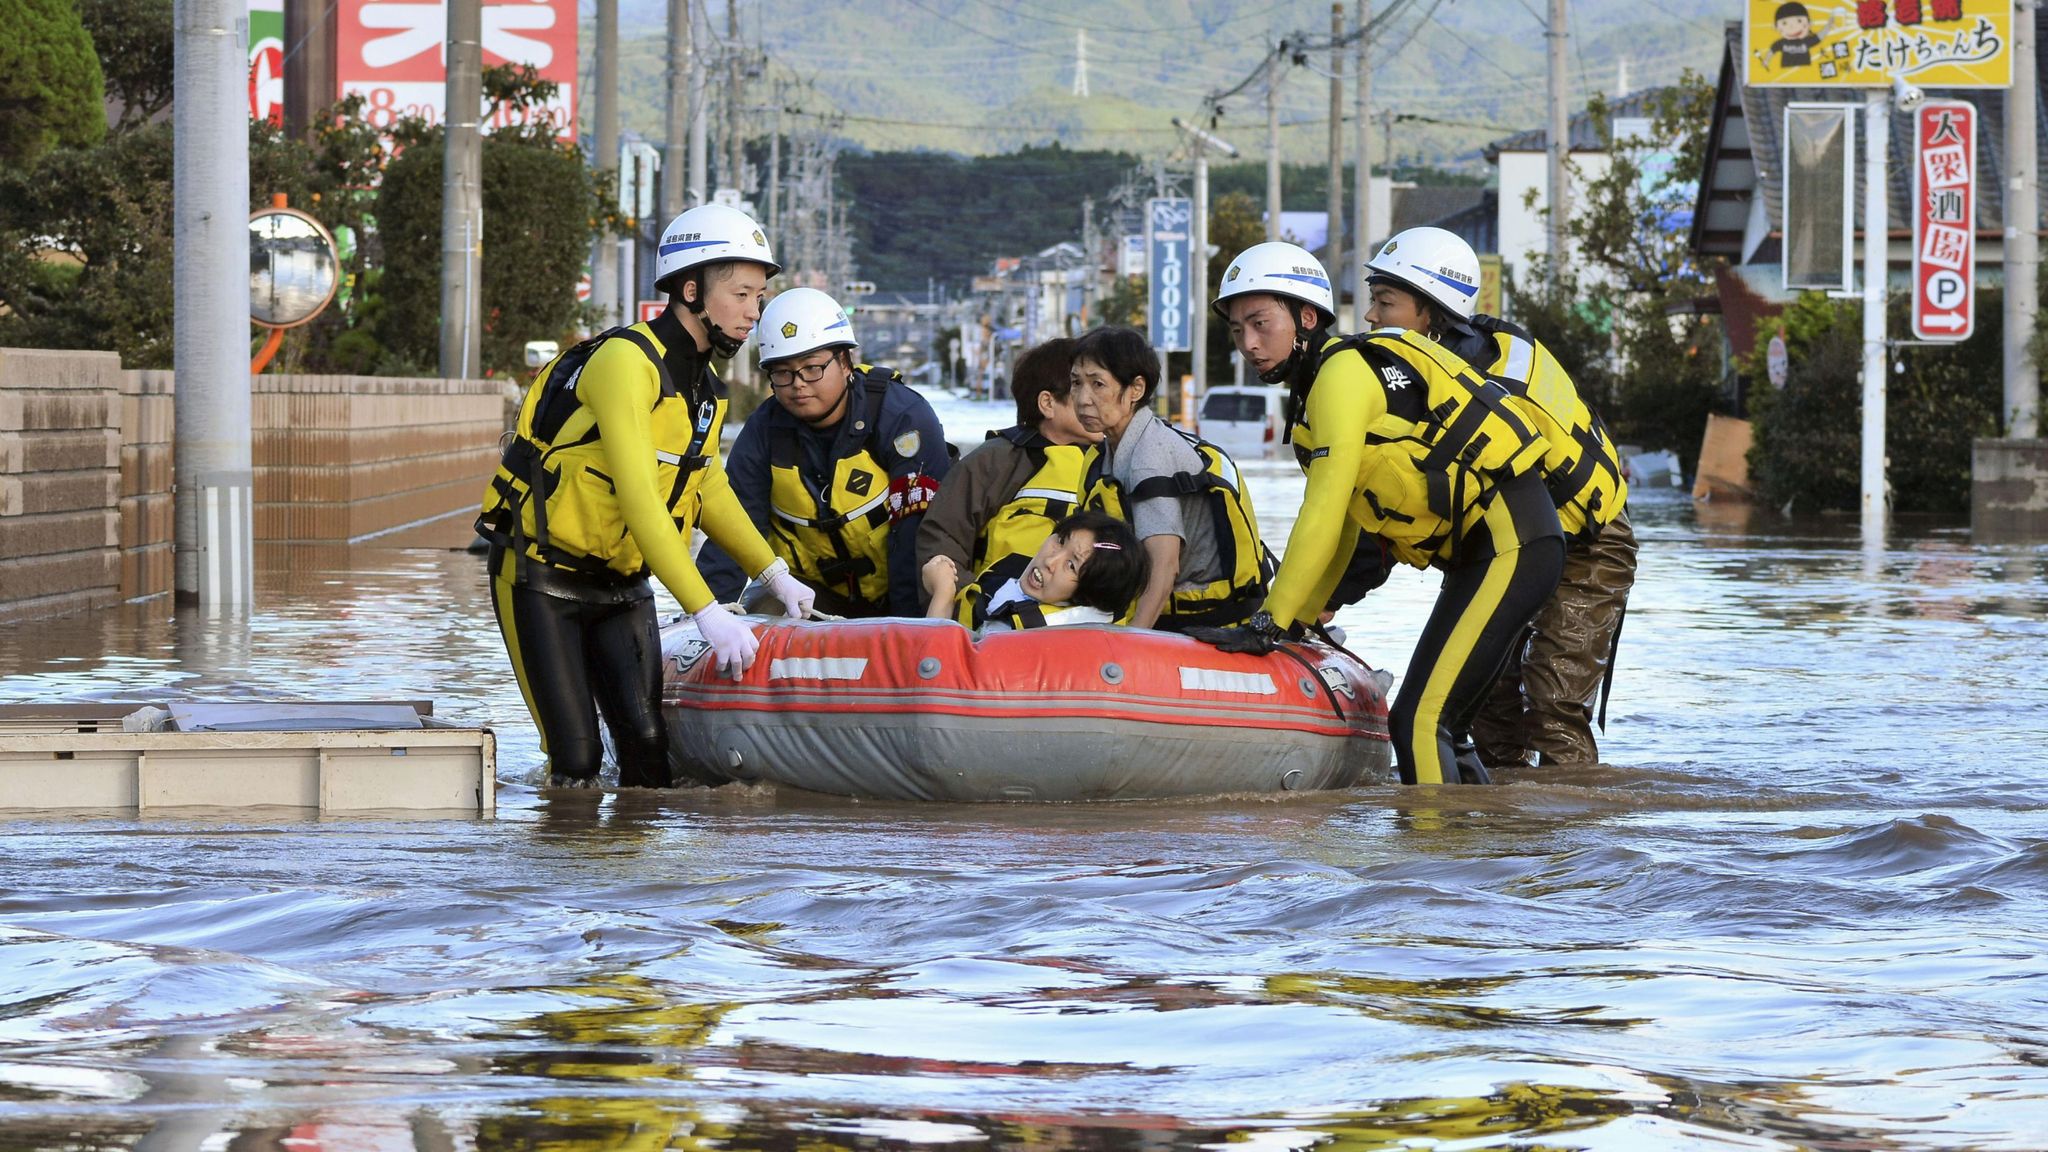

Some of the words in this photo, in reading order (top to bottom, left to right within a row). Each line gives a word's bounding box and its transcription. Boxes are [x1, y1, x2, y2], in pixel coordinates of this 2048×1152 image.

[1857, 18, 2000, 69] たけちゃんち
[1926, 109, 1966, 265] 大衆酒場
[666, 232, 702, 244] 福島県警察
[1937, 278, 1958, 304] P
